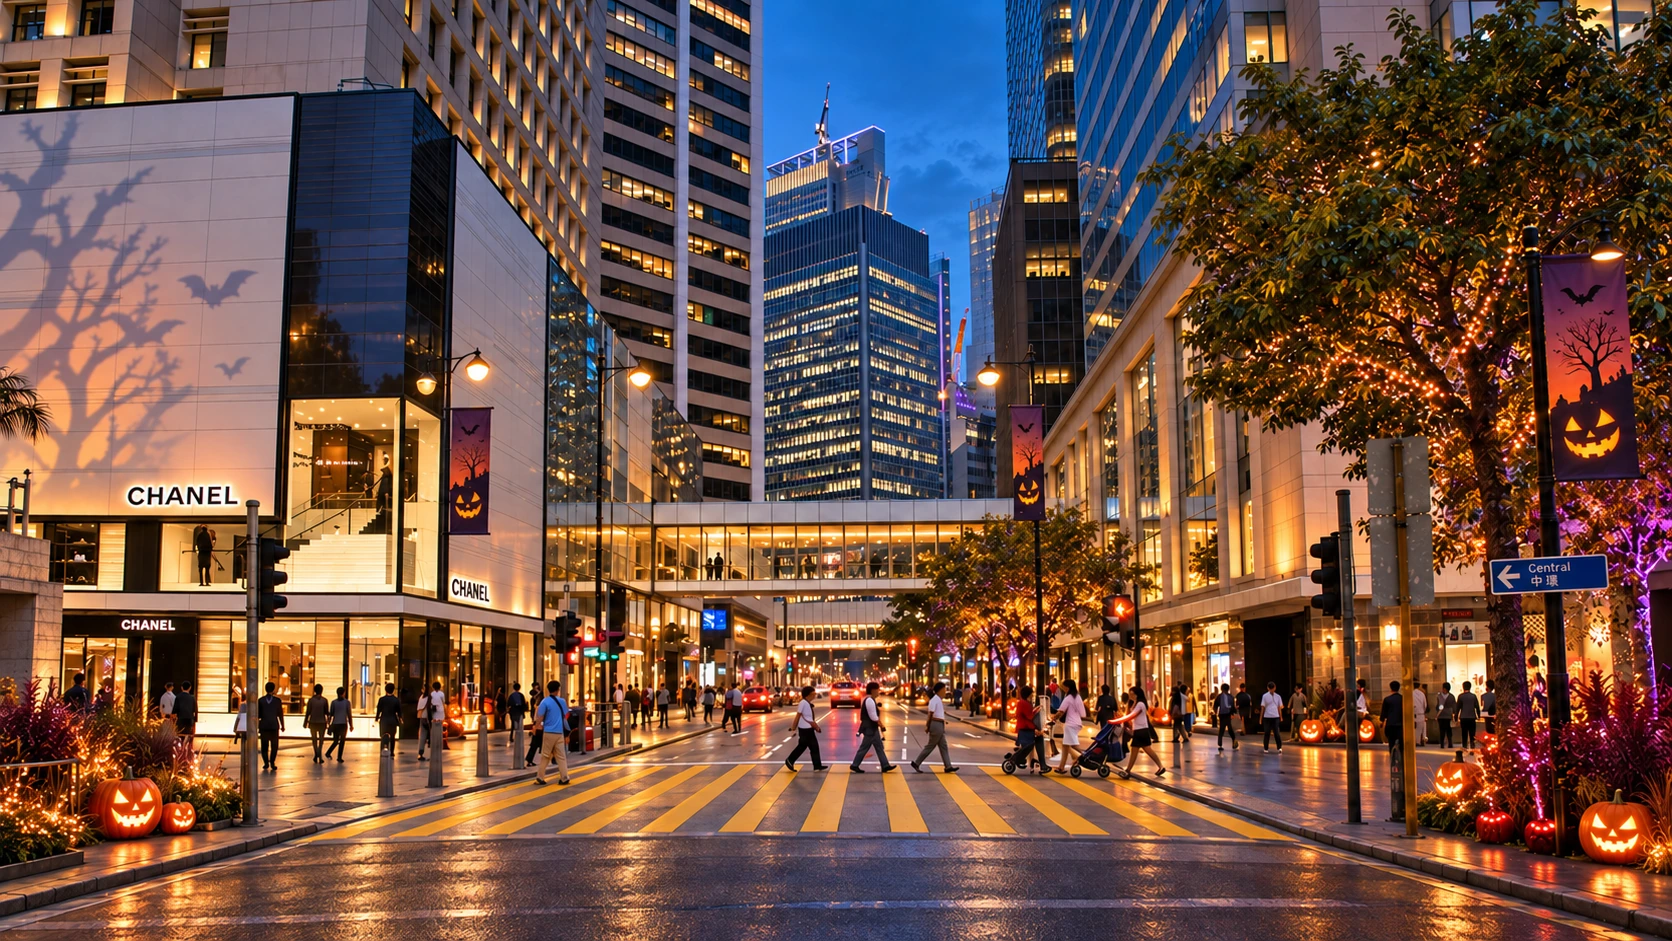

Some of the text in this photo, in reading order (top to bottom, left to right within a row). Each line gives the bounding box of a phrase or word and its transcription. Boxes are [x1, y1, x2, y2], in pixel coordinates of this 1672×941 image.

[127, 486, 238, 506] CHANEL
[1528, 561, 1571, 574] Central
[451, 578, 490, 602] CHANEL
[121, 619, 176, 631] CHANEL
